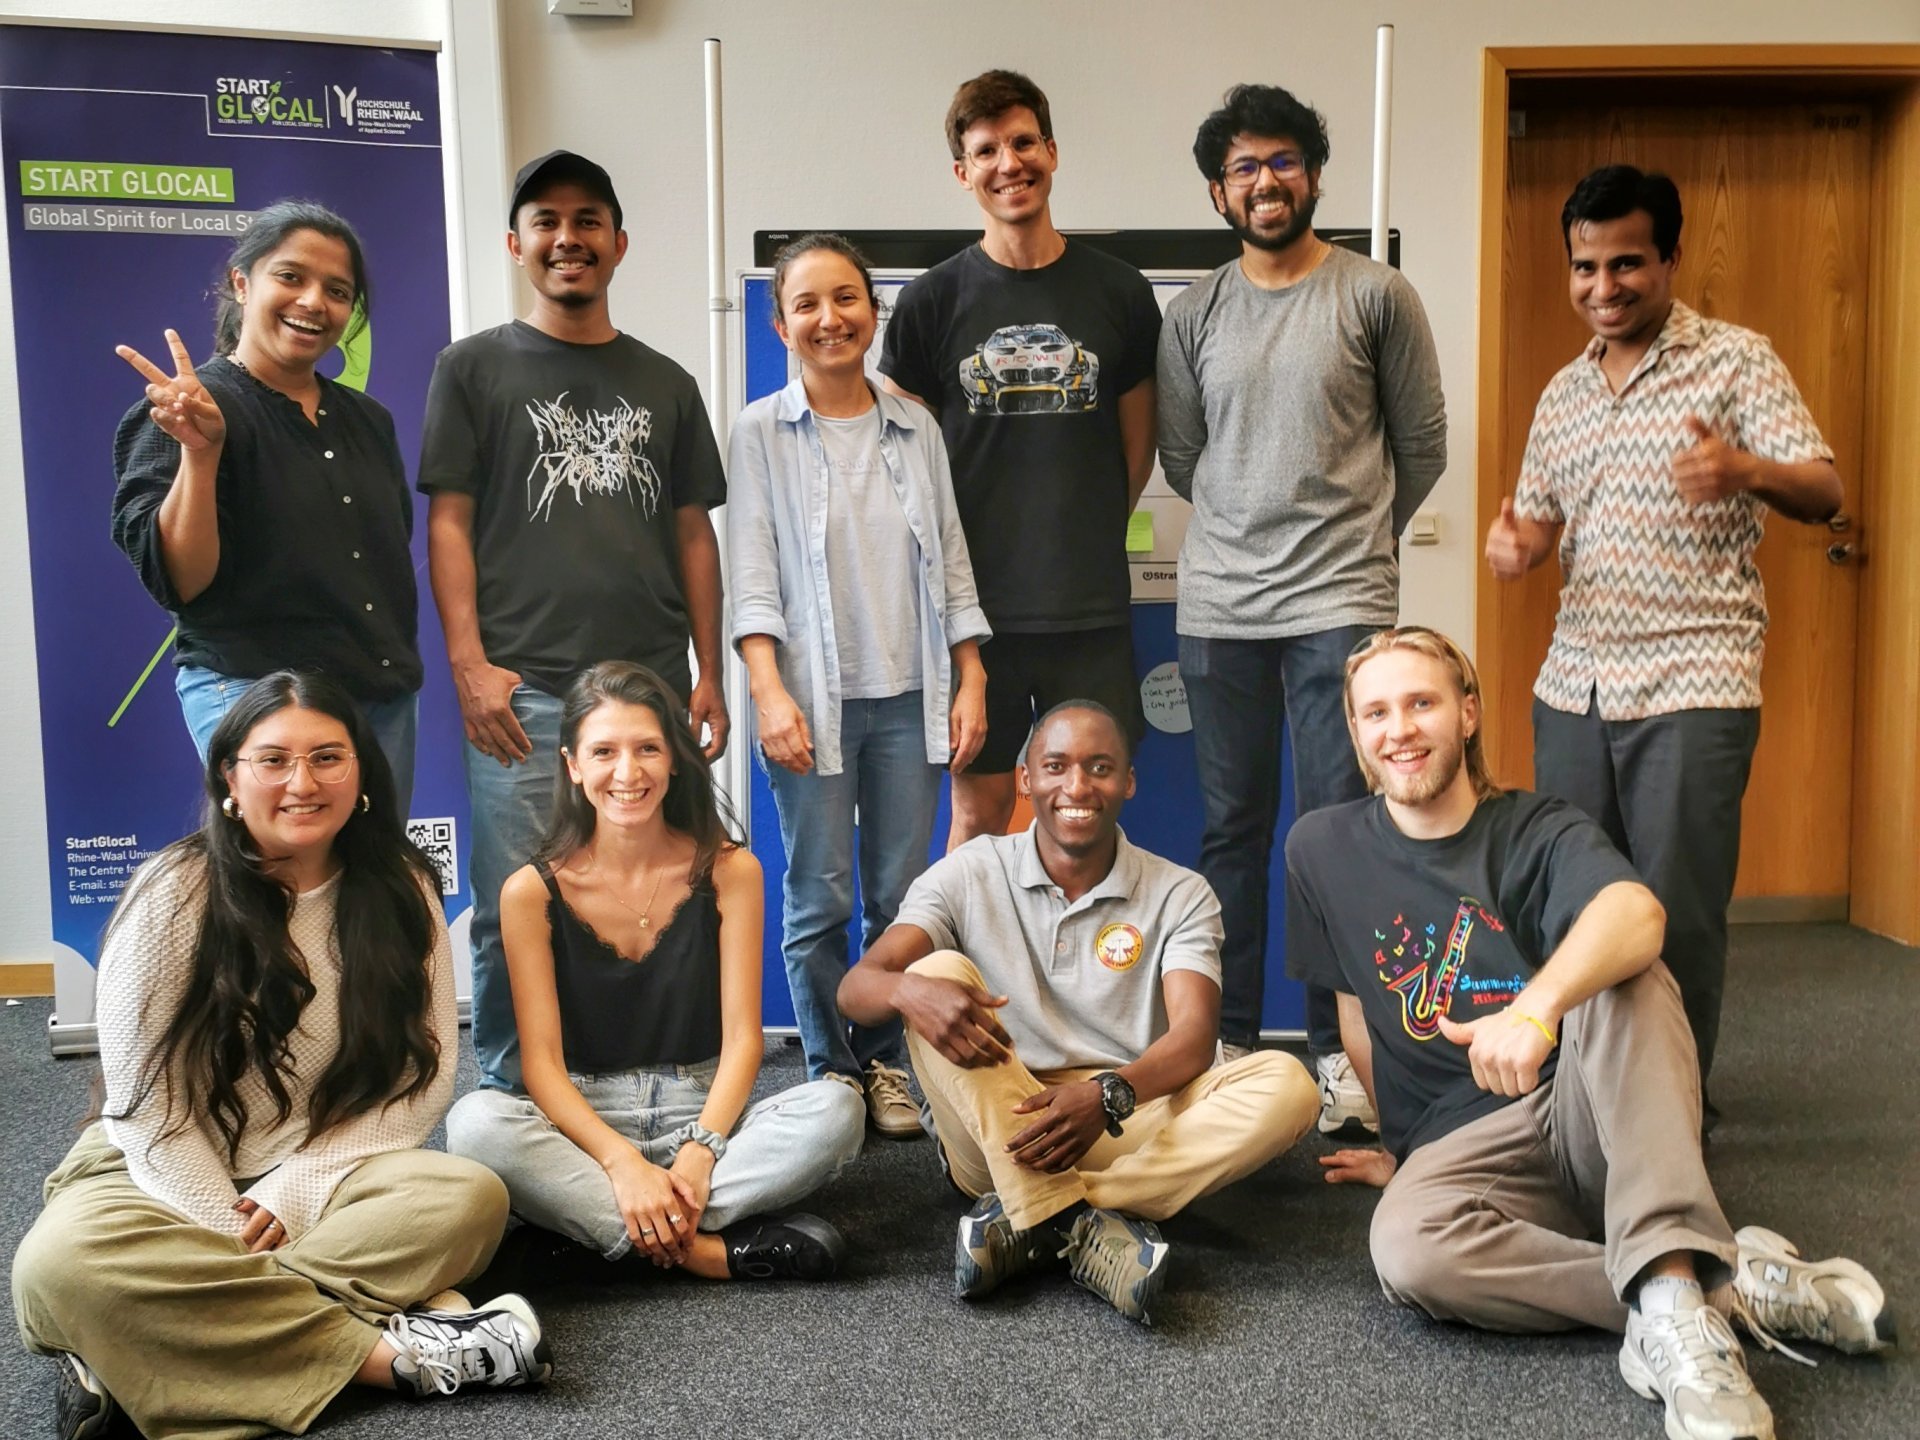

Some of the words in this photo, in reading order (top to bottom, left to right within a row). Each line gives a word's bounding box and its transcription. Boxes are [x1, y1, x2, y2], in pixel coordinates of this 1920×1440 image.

[216, 77, 270, 95] START
[356, 99, 411, 110] HOCHSCHULE
[357, 108, 424, 121] RHEIN-WAAL
[28, 167, 114, 193] START
[122, 170, 227, 198] GLOCAL
[28, 207, 89, 227] Global
[93, 208, 145, 232] Spirit
[149, 211, 177, 229] for
[181, 212, 231, 231] Local
[65, 834, 138, 849] StartGlocal
[67, 850, 127, 863] Rhine-Waal
[68, 867, 87, 877] The
[89, 865, 124, 876] Centre
[69, 880, 107, 891] E-mail:
[69, 894, 95, 905] Web:
[1763, 1263, 1789, 1285] N
[1649, 1343, 1671, 1374] N
